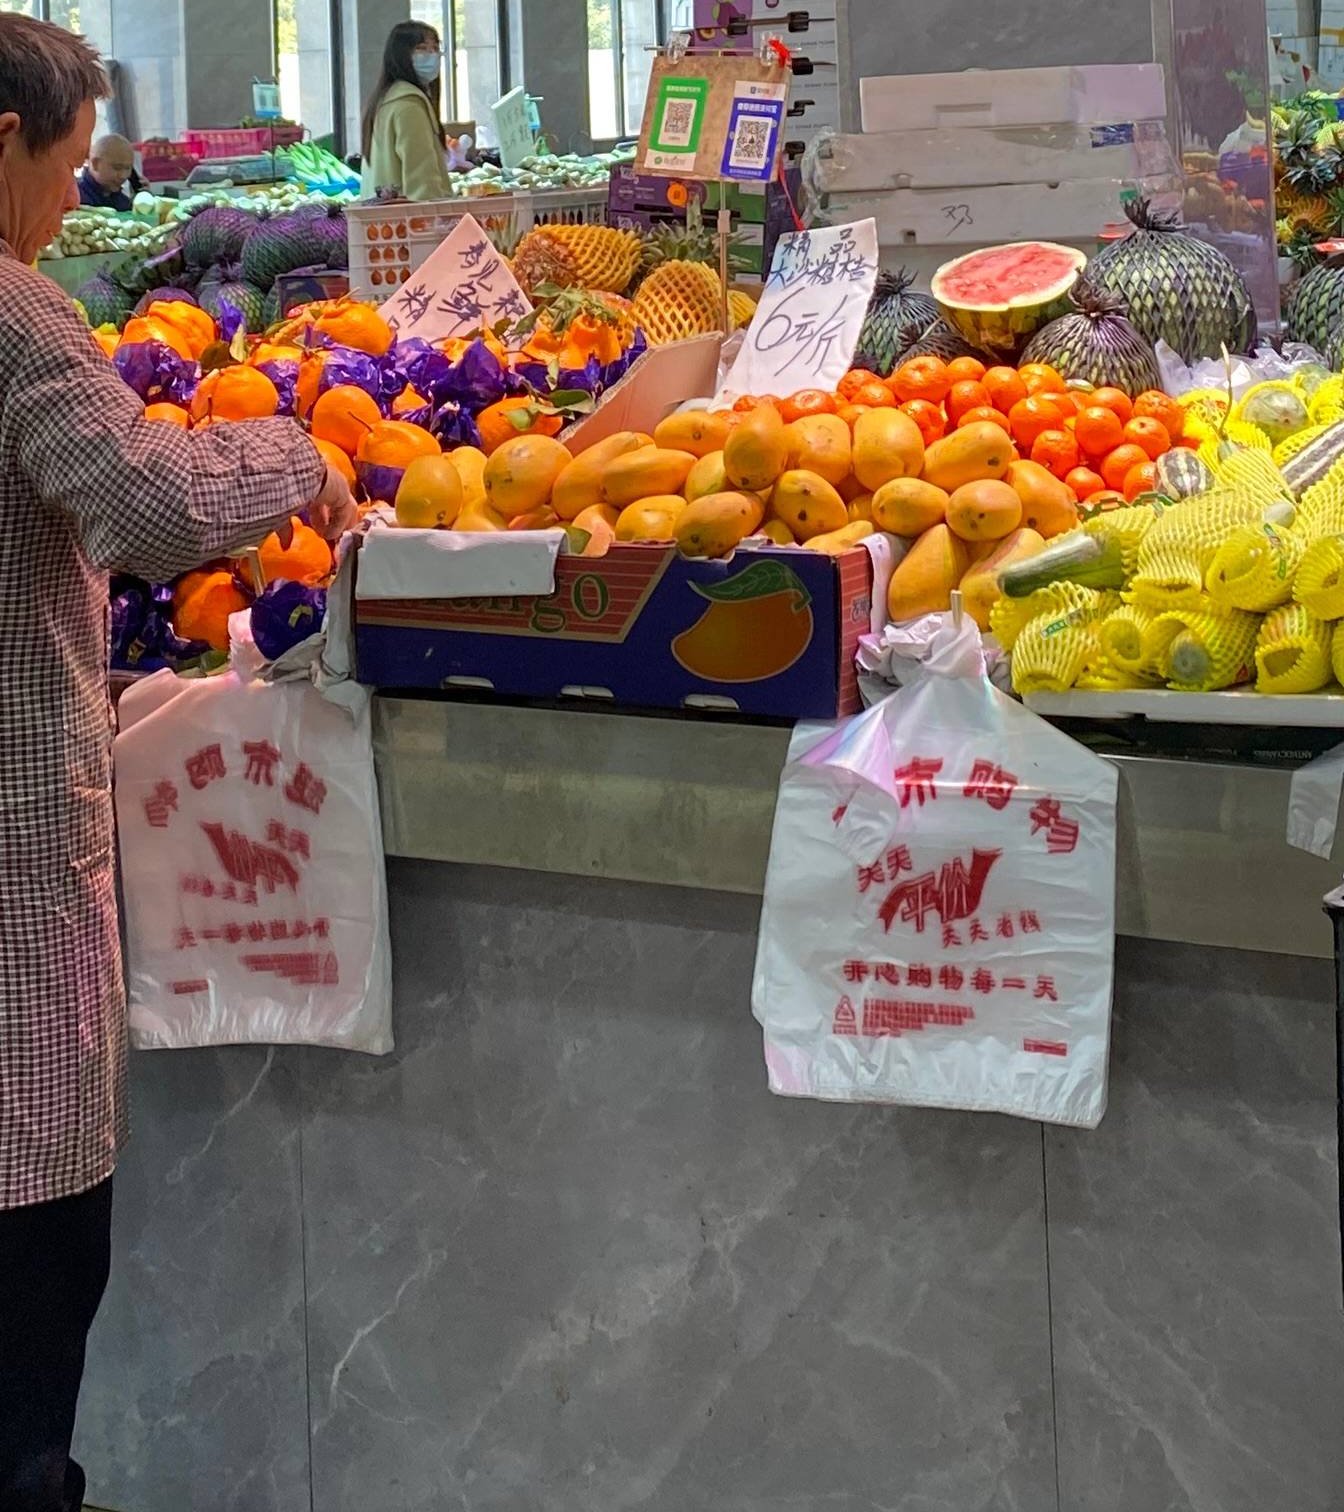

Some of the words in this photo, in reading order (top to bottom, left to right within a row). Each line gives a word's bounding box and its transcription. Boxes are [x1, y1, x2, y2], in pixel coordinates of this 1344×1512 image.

[783, 227, 858, 263] 精品
[842, 959, 1059, 1001] 开心购物每一天
